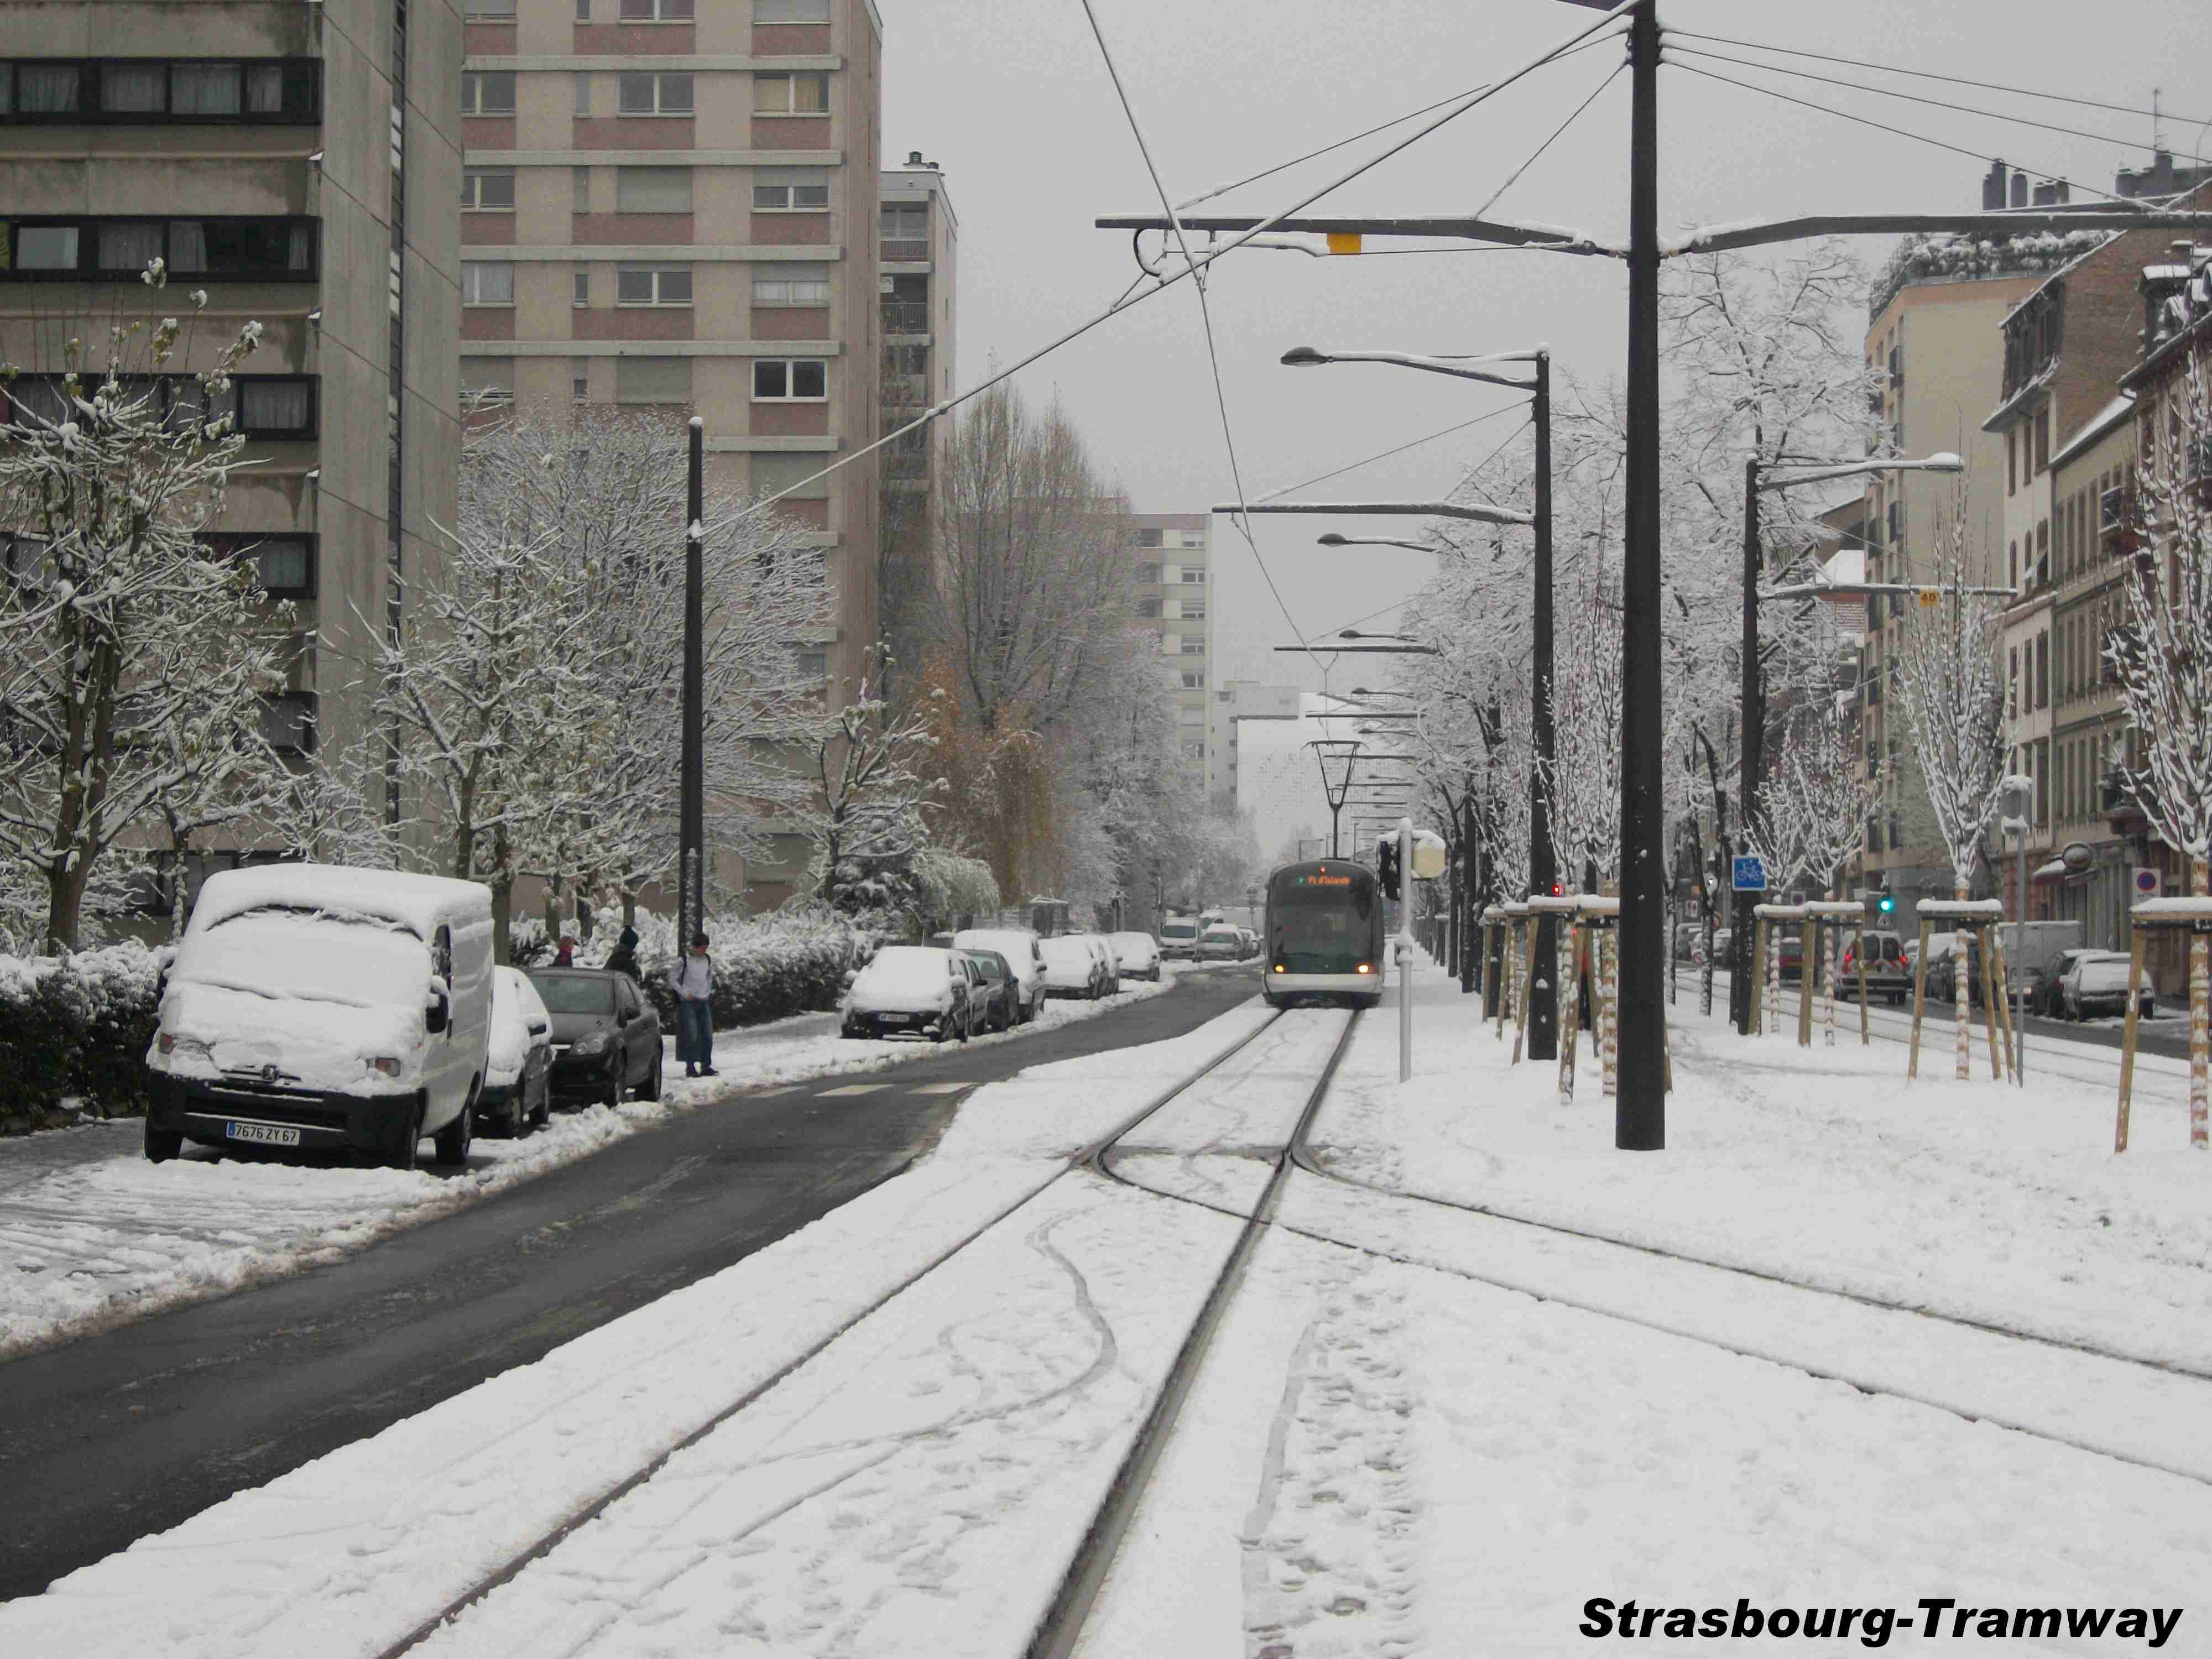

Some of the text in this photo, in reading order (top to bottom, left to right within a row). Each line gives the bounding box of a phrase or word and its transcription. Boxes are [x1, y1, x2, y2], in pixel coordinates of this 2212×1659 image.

[236, 1125, 297, 1141] 7676 ZY 67
